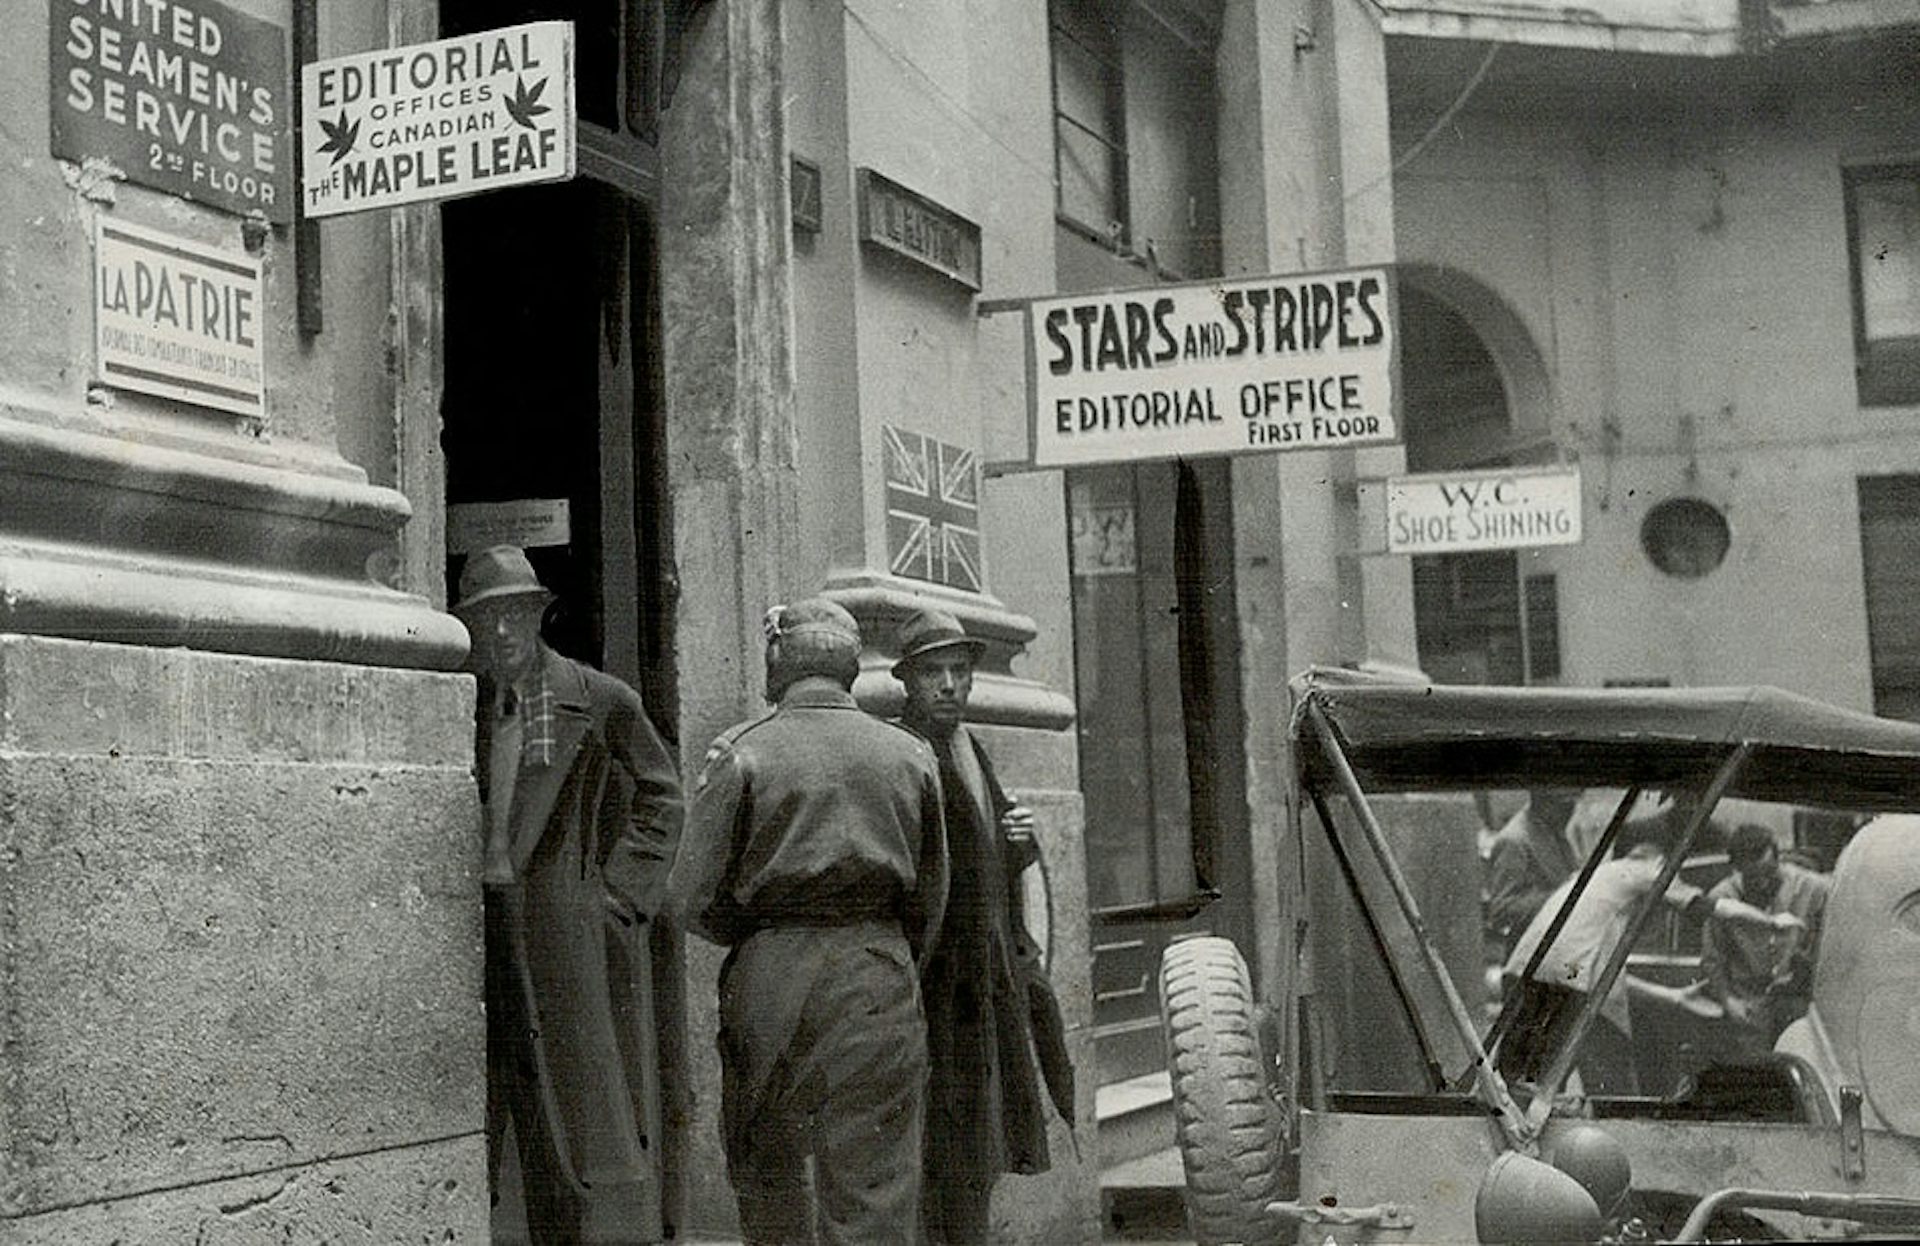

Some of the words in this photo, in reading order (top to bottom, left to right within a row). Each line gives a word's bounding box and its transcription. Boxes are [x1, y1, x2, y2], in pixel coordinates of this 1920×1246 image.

[66, 16, 274, 126] SEAMEN'S
[318, 34, 540, 108] EDITORIAL
[67, 68, 275, 174] SERVICE
[370, 85, 493, 120] OFFICES
[370, 111, 495, 149] CANADIAN
[192, 161, 276, 204] FLOOR
[309, 171, 339, 206] THE
[343, 145, 458, 200] MAPLE
[471, 128, 557, 179] LEAF
[102, 266, 130, 315] LA
[135, 260, 255, 349] PATRIE
[1045, 297, 1179, 376] STARS
[1183, 321, 1226, 360] AND
[1222, 278, 1385, 356] STRIPES
[1056, 387, 1223, 434] EDITORIAL
[1240, 374, 1362, 419] OFFICE
[1248, 420, 1304, 445] FIRST
[1312, 416, 1381, 440] FLOOR
[1439, 475, 1529, 508] W.C.
[1394, 510, 1458, 544] SHOE
[1466, 506, 1571, 541] SHINING
